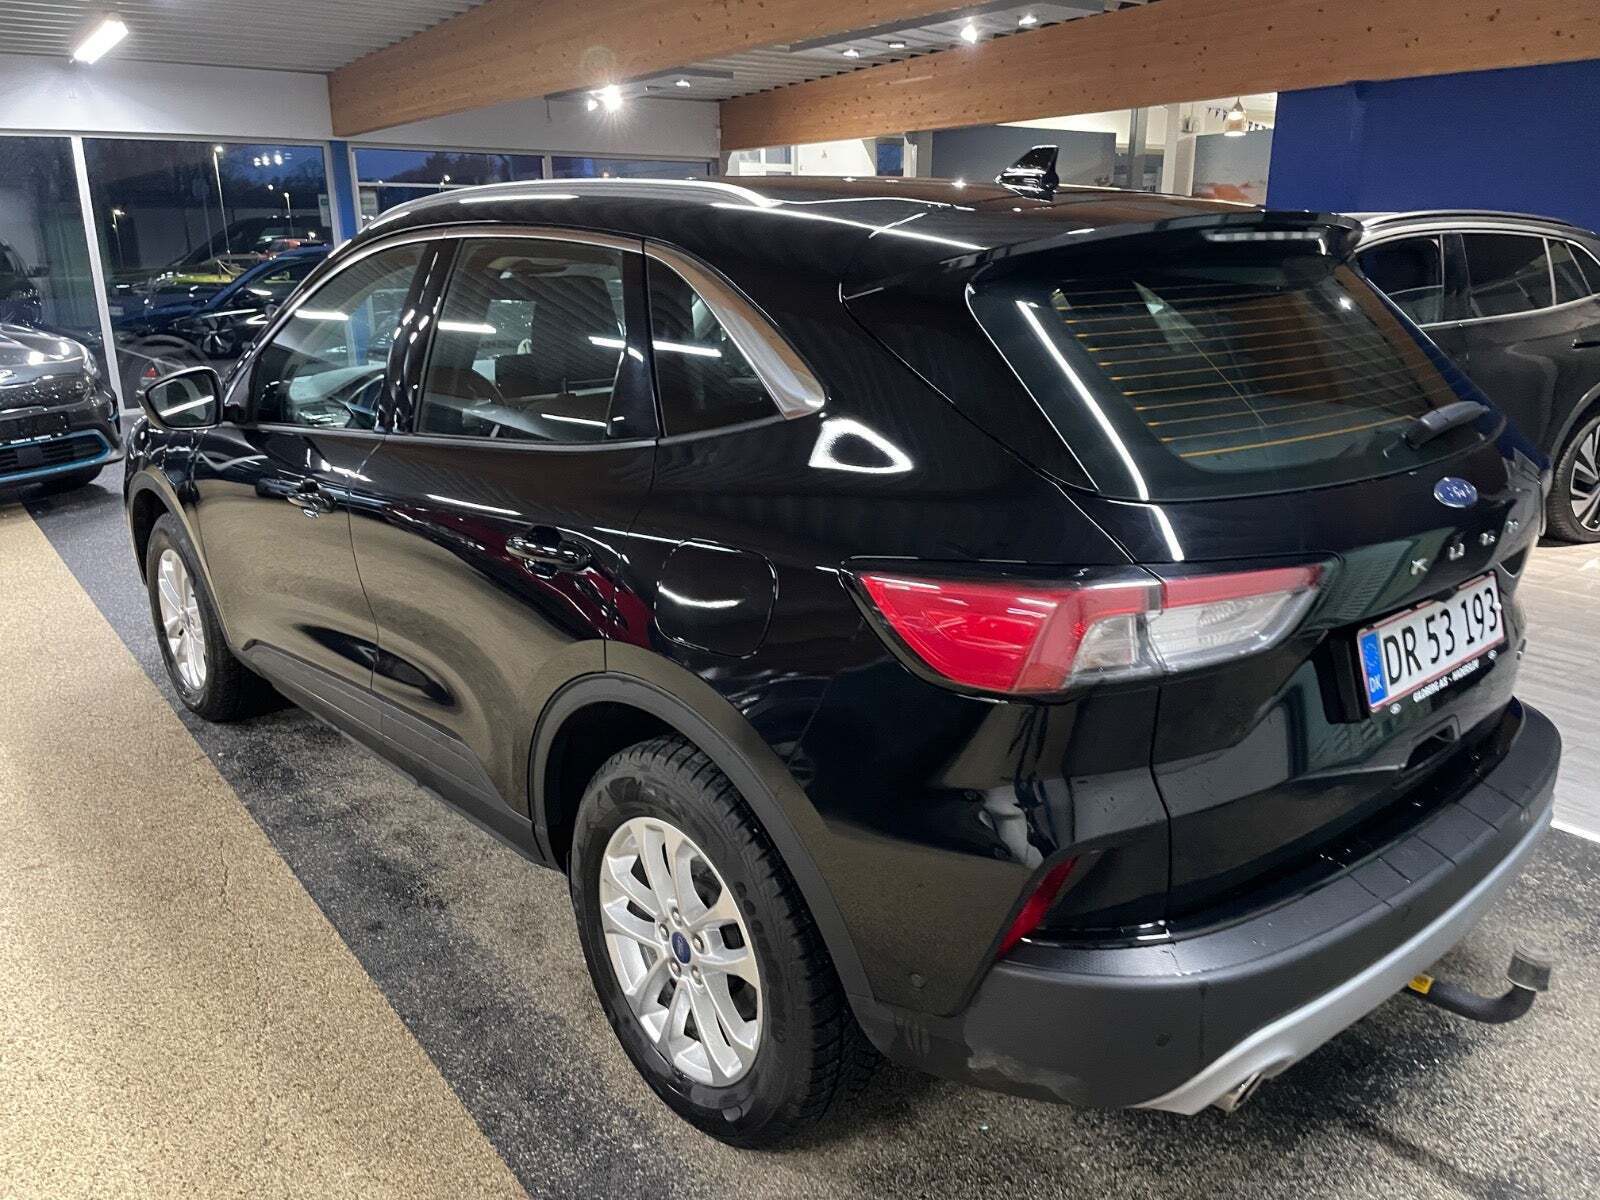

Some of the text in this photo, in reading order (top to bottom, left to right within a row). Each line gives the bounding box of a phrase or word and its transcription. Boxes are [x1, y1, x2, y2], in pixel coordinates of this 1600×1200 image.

[1383, 625, 1422, 686] DR
[1425, 608, 1455, 665] 53
[1461, 587, 1498, 646] 193
[1369, 674, 1383, 693] DK
